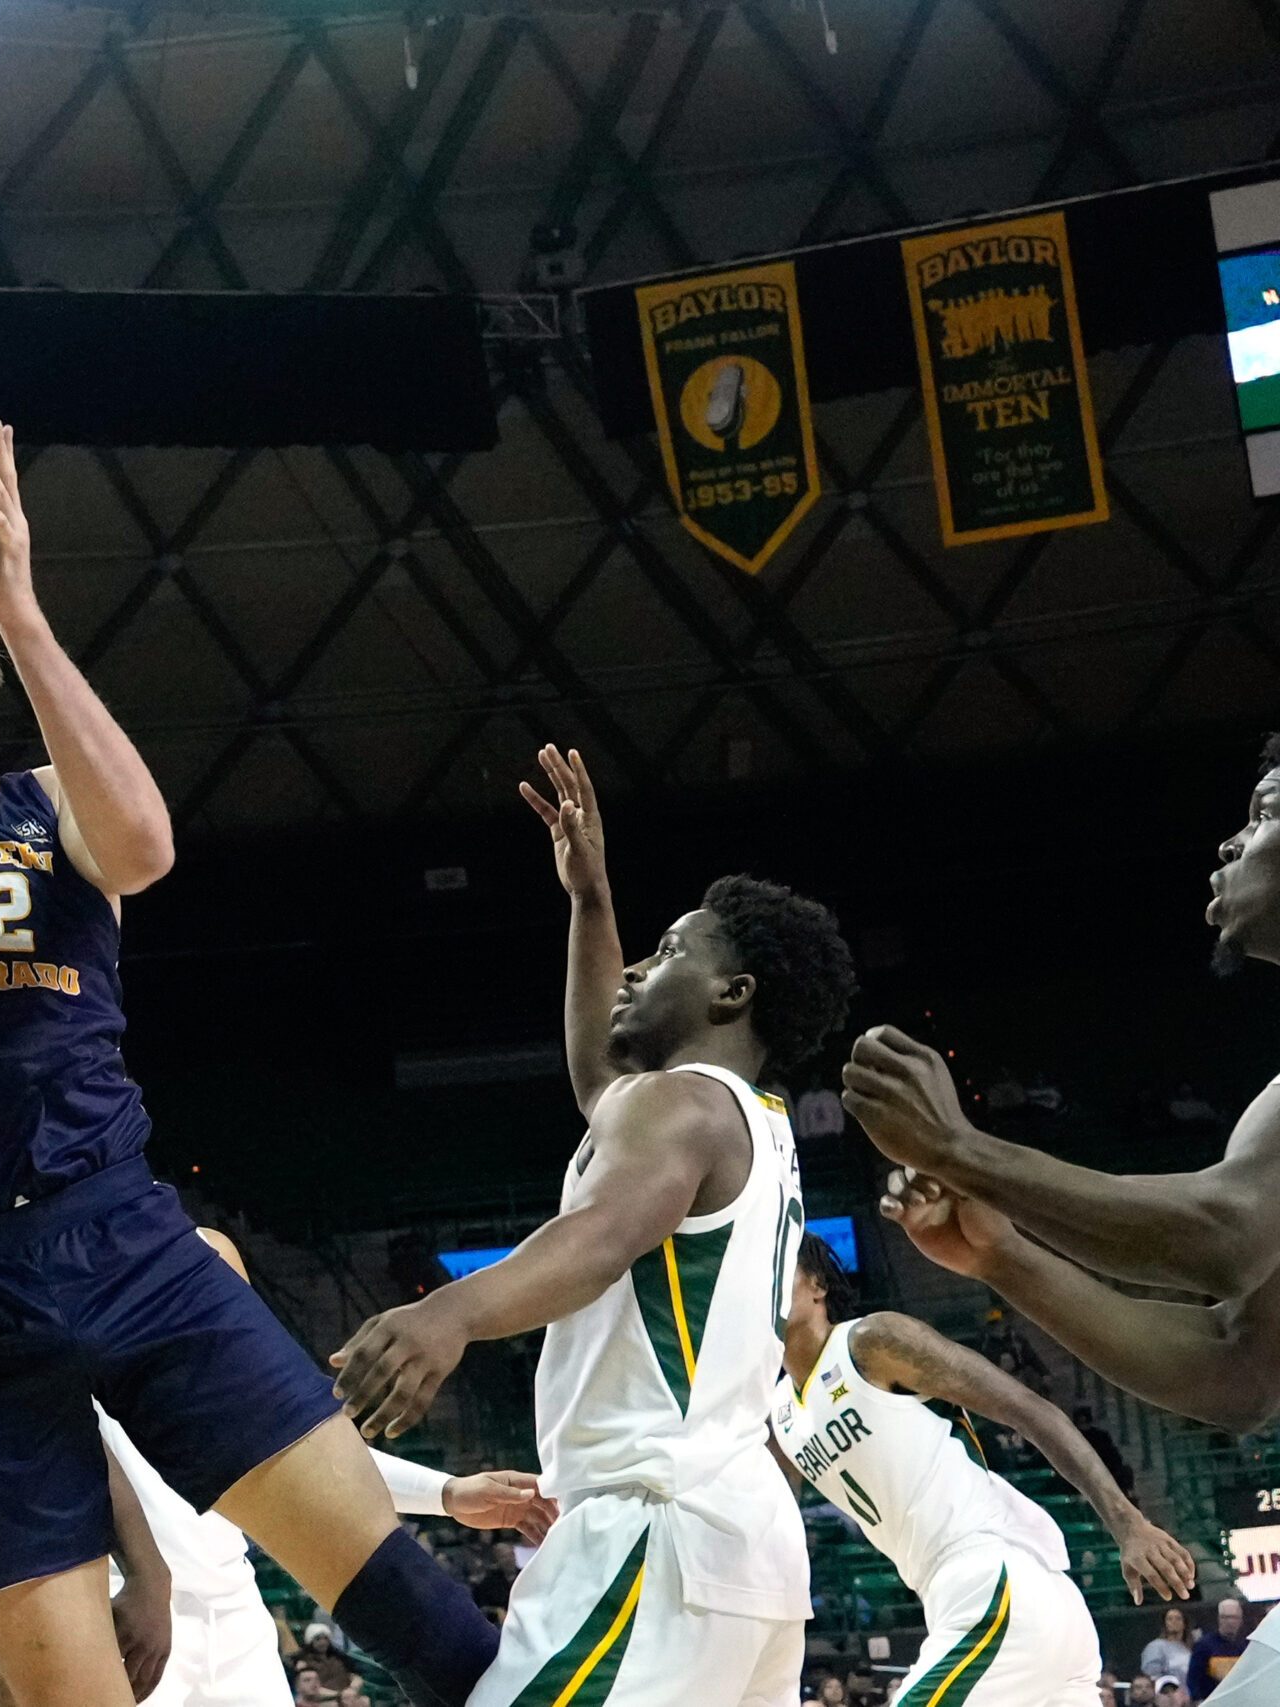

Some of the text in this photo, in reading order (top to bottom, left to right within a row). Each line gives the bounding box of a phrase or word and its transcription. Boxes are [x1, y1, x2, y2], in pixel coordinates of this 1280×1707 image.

[918, 237, 1057, 288] BAYLOR
[650, 284, 786, 335] BAYLOR
[943, 366, 1071, 404] IMMORTAL
[966, 390, 1051, 431] TEN
[795, 1407, 872, 1482] BAYLOR
